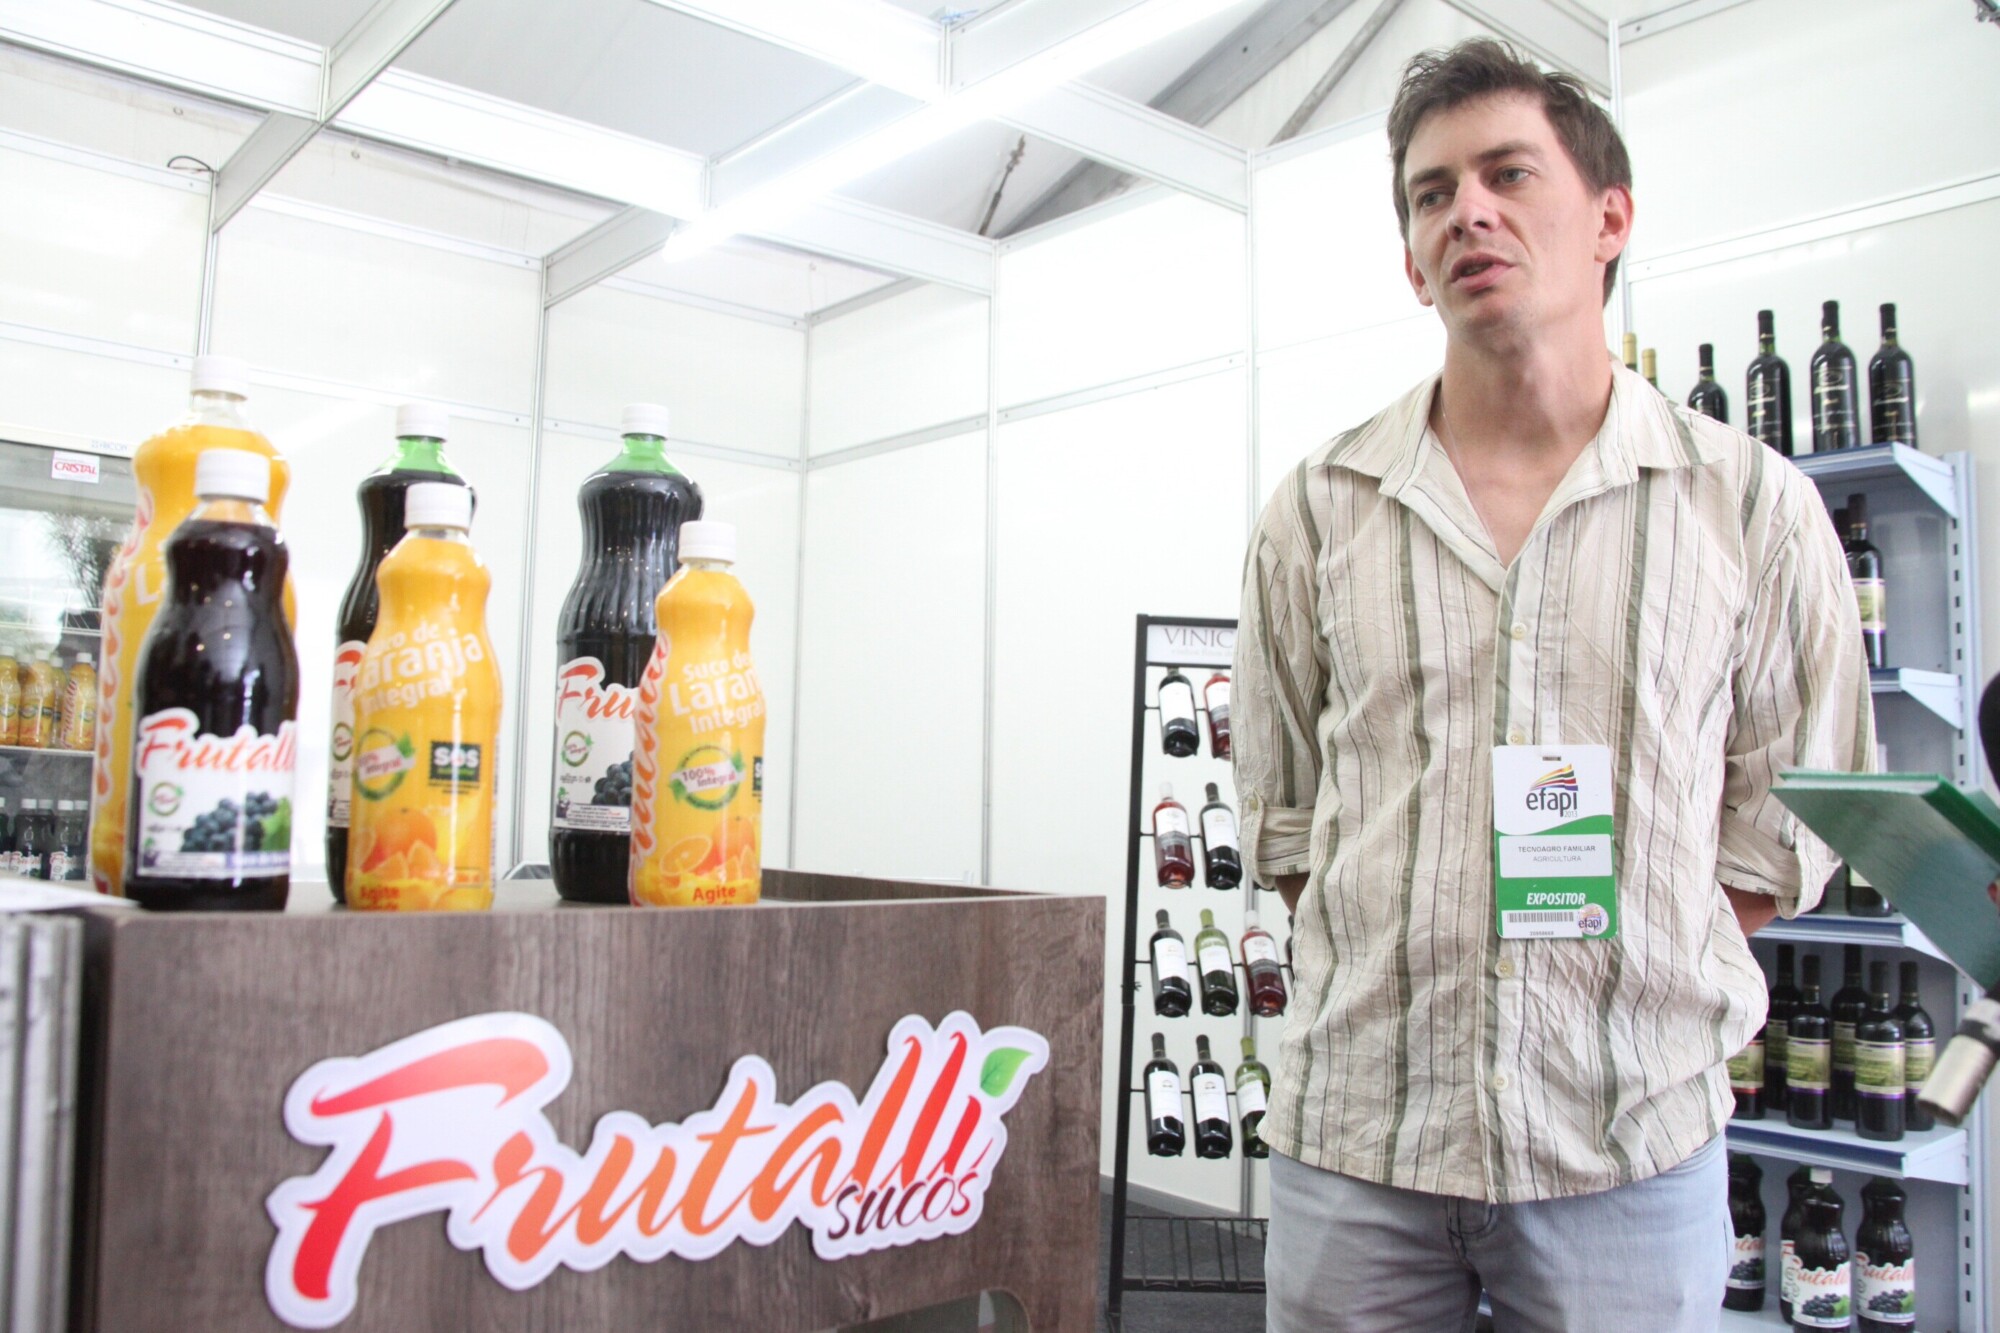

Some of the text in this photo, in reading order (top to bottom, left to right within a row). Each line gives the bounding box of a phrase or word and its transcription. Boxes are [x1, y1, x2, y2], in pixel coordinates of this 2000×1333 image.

[54, 461, 97, 475] CRISTAL
[1164, 627, 1234, 649] VINIC
[682, 659, 730, 683] Suco
[557, 663, 635, 720] Fru
[669, 667, 759, 717] Laran
[433, 745, 480, 769] SOS
[682, 766, 716, 781] 100%
[1525, 787, 1578, 818] efapi
[693, 884, 736, 902] Agite
[1526, 892, 1587, 906] EXPOSITOR
[1578, 916, 1602, 931] efapi
[293, 1031, 994, 1302] Frutalli
[827, 1171, 979, 1241] sucos
